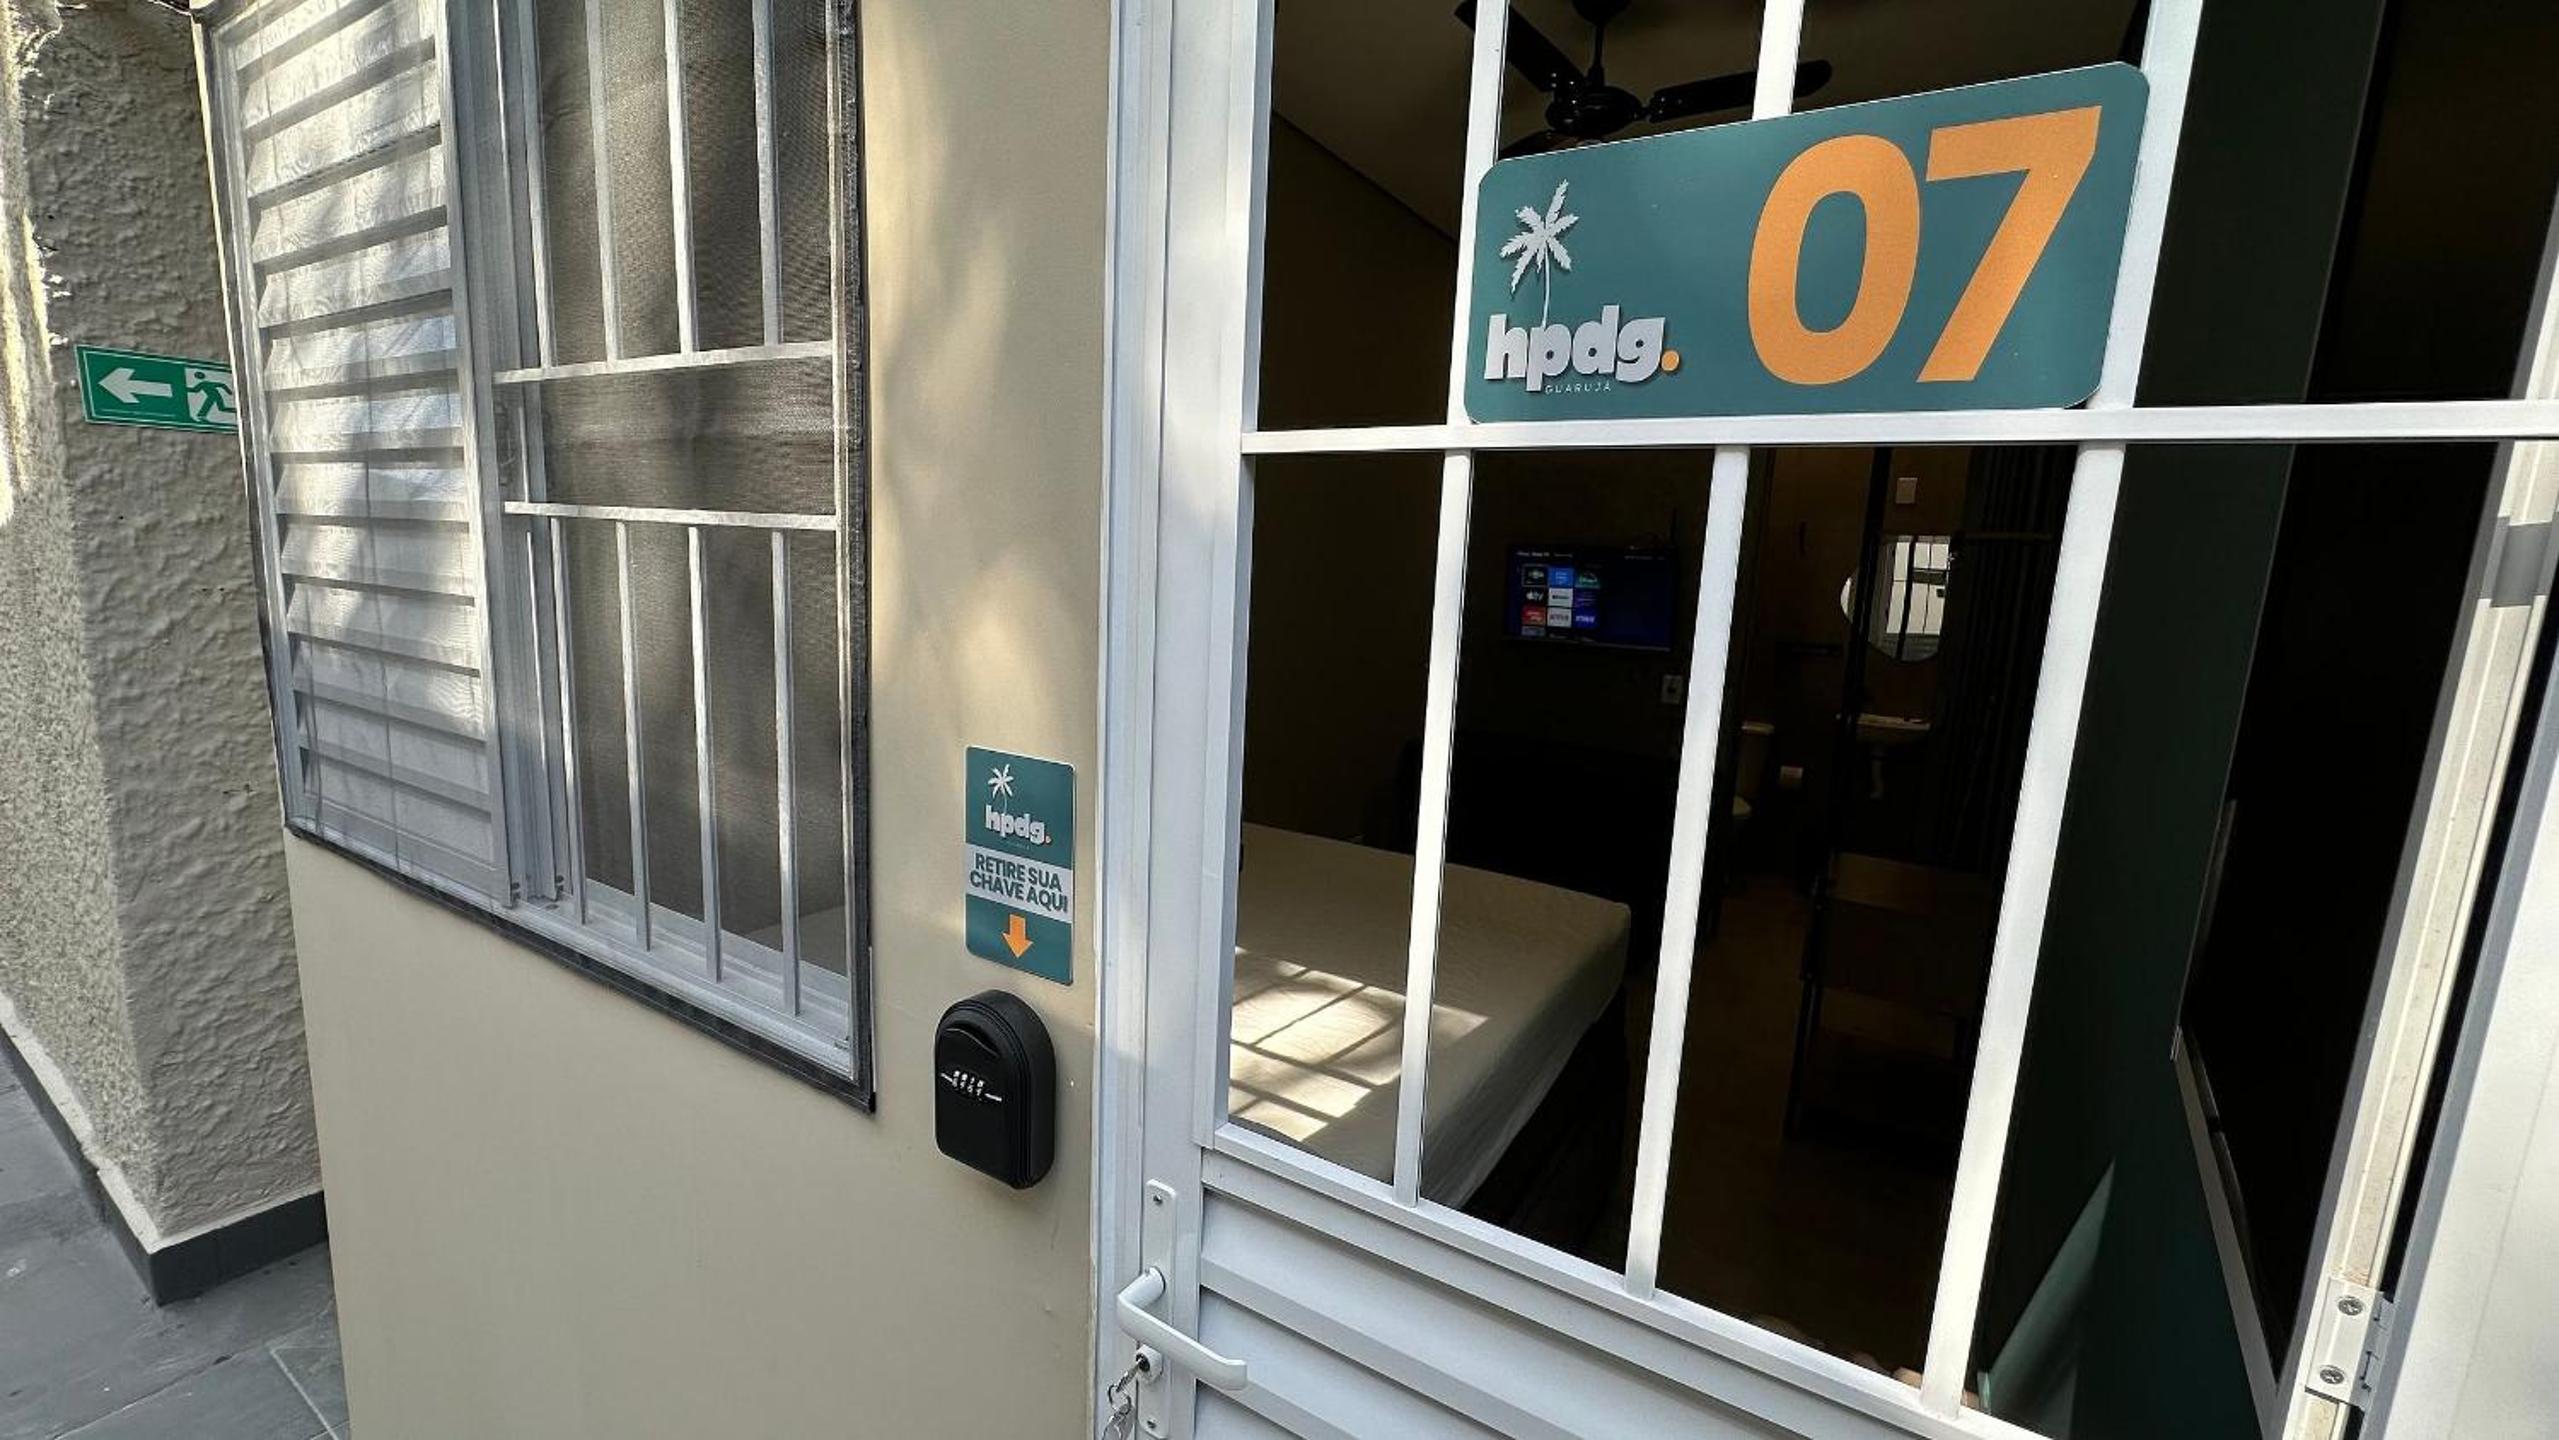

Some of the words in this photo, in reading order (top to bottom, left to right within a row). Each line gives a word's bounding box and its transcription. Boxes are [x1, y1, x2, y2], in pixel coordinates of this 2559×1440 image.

[1746, 105, 2103, 386] 07
[1483, 304, 1680, 392] hpdg.
[969, 869, 1026, 901] CHAVE
[1026, 886, 1069, 913] AQUI
[975, 852, 1026, 882] RETIRE
[1027, 866, 1063, 892] SUA
